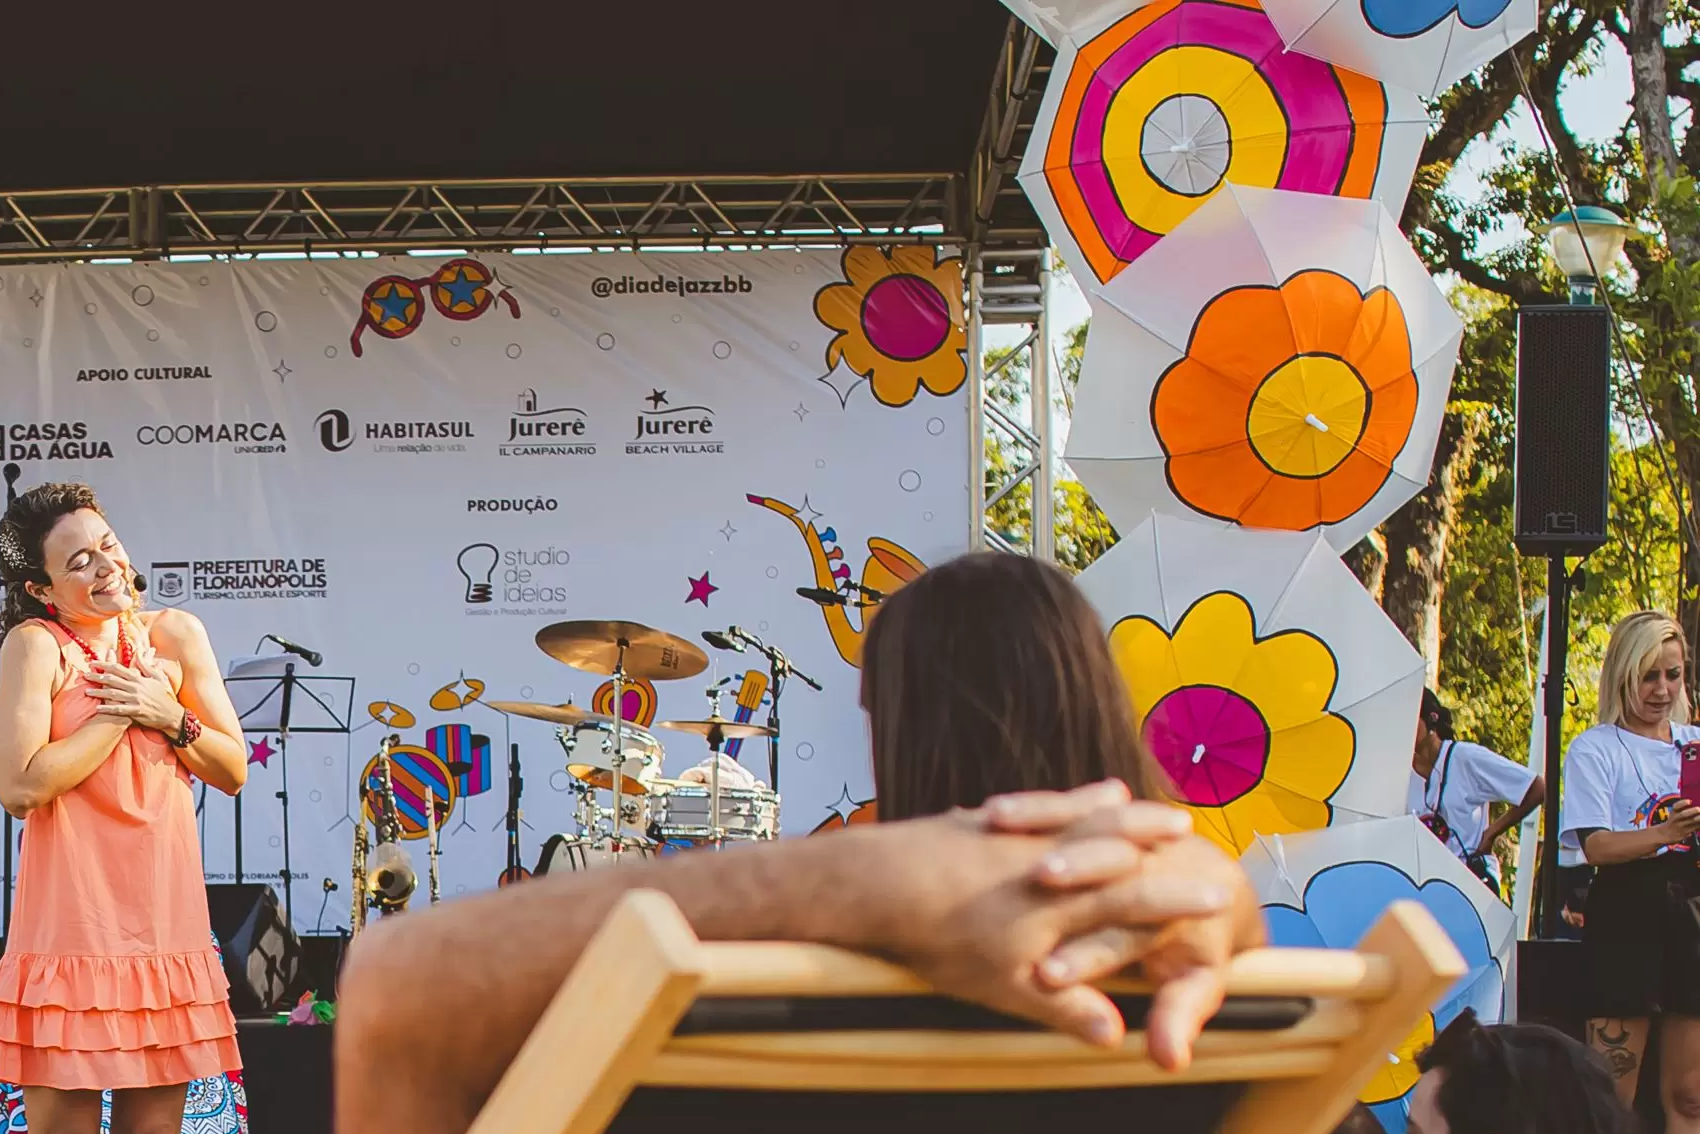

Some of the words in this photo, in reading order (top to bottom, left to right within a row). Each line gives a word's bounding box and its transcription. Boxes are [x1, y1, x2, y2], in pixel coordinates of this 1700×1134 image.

[591, 274, 753, 298] @diadejazzbb
[76, 368, 129, 382] APOIO
[134, 365, 213, 381] CULTURAL
[9, 422, 88, 441] CASAS
[136, 422, 287, 445] COOMARCA
[365, 421, 475, 439] HABITASUL
[508, 416, 586, 441] Jurerê
[634, 415, 713, 440] Jurerê
[10, 443, 43, 460] DA
[47, 440, 114, 460] ÁGUA
[499, 447, 511, 457] IL
[512, 446, 597, 457] CAMPANARIO
[625, 445, 669, 454] BEACH
[673, 444, 724, 454] VILLAGE
[467, 495, 558, 515] PRODUÇÃO
[503, 546, 570, 566] studio
[192, 559, 298, 575] PREFEITURA
[301, 558, 326, 573] DE
[503, 566, 532, 583] de
[192, 573, 327, 590] FLORIANÓPOLIS
[503, 584, 567, 603] ideias
